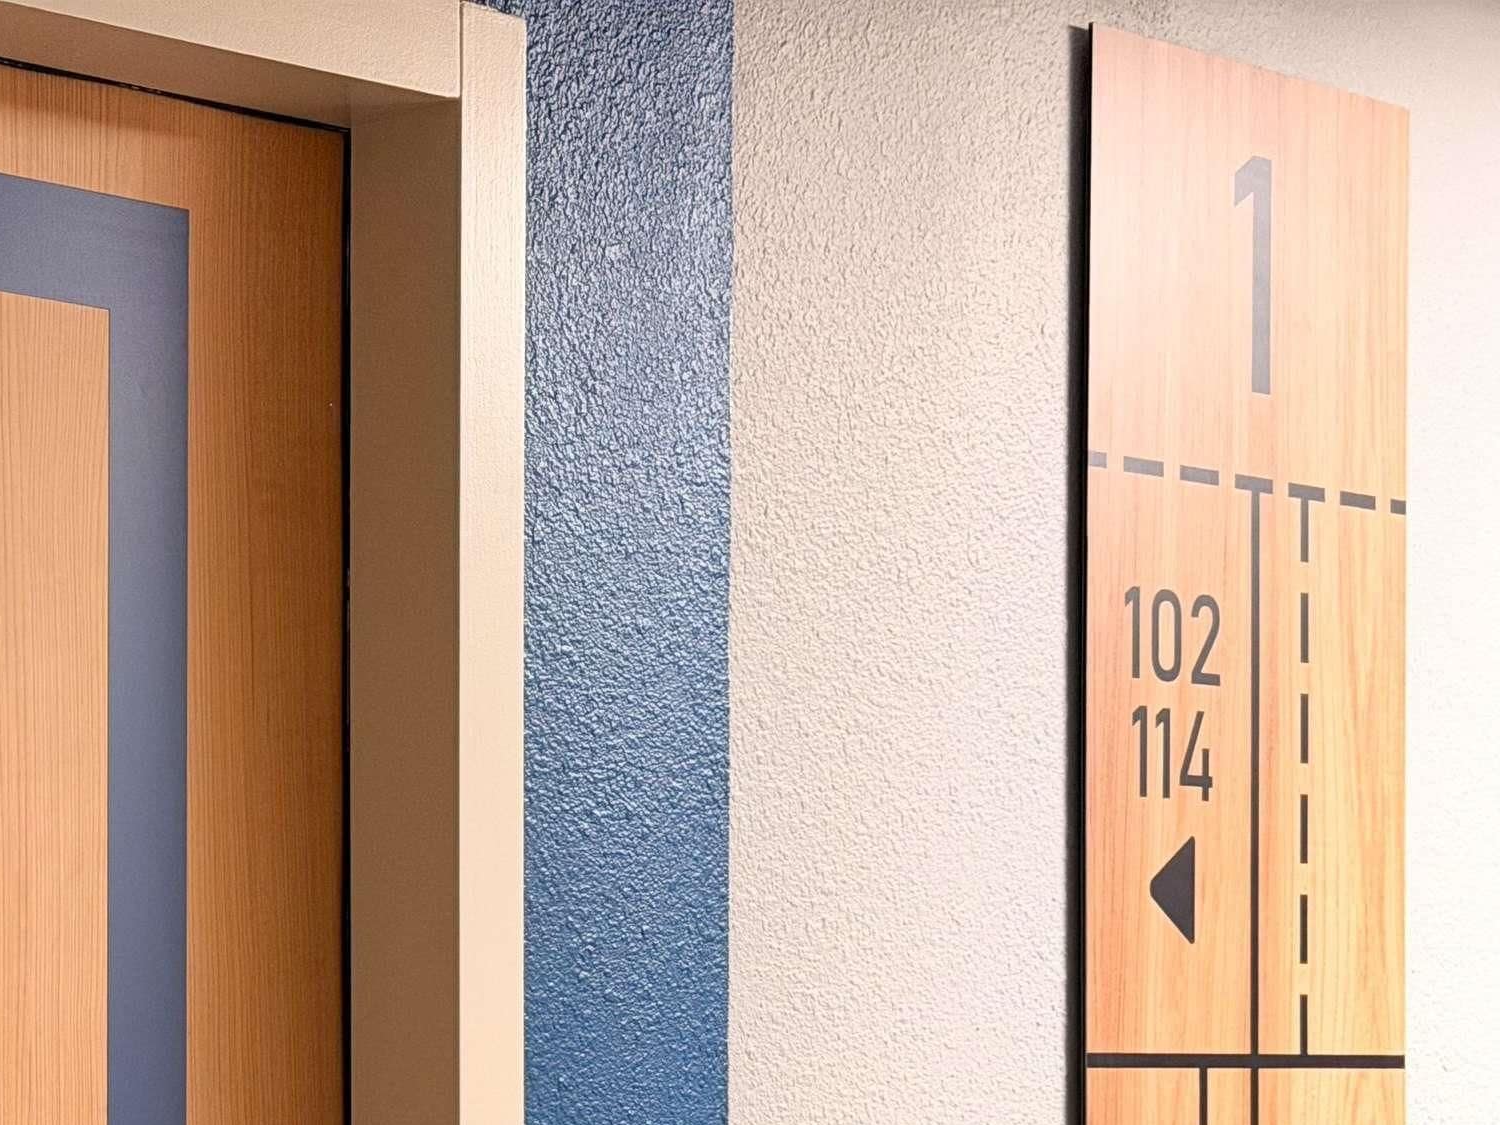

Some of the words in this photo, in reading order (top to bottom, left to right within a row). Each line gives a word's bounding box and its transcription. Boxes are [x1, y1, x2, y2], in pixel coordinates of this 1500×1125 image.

[1234, 155, 1272, 395] 1
[1124, 586, 1221, 686] 102
[1131, 705, 1213, 801] 114
